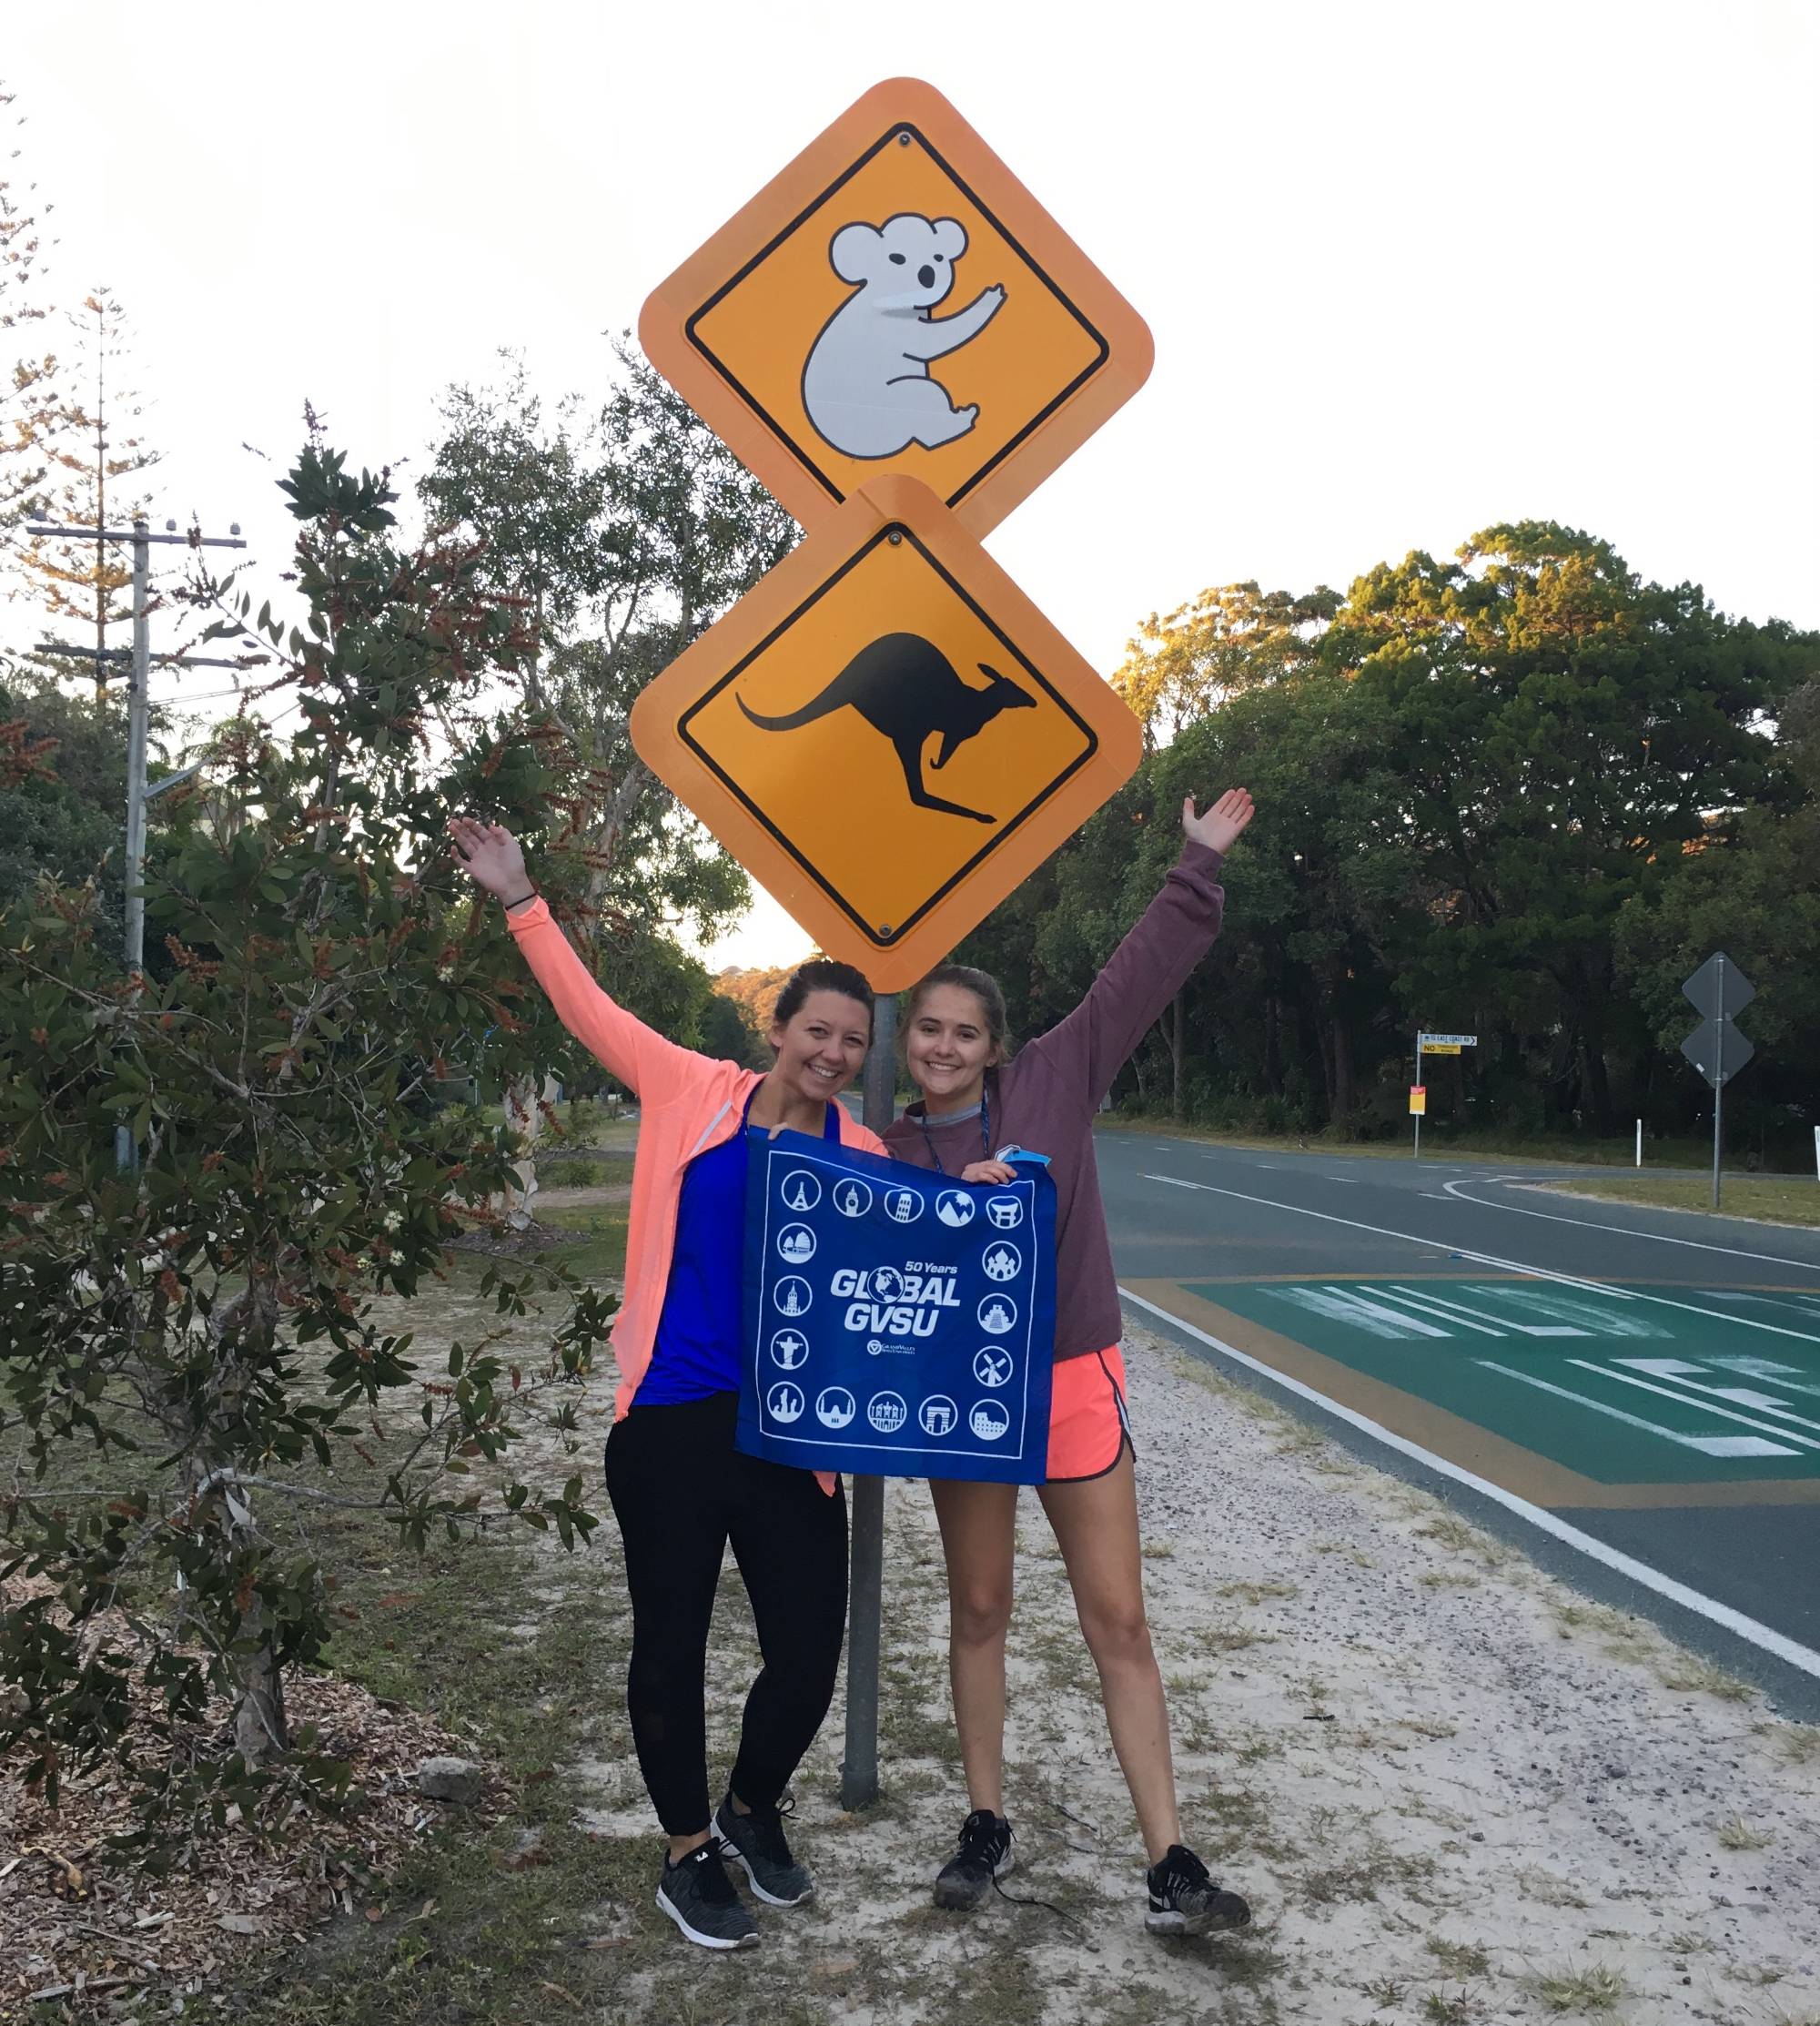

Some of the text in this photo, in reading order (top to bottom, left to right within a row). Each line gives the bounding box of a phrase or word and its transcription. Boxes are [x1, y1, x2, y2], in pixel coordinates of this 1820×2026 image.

[905, 1261, 958, 1274] 50 Years
[830, 1266, 961, 1307] GLOBAL
[844, 1302, 940, 1337] GVSU
